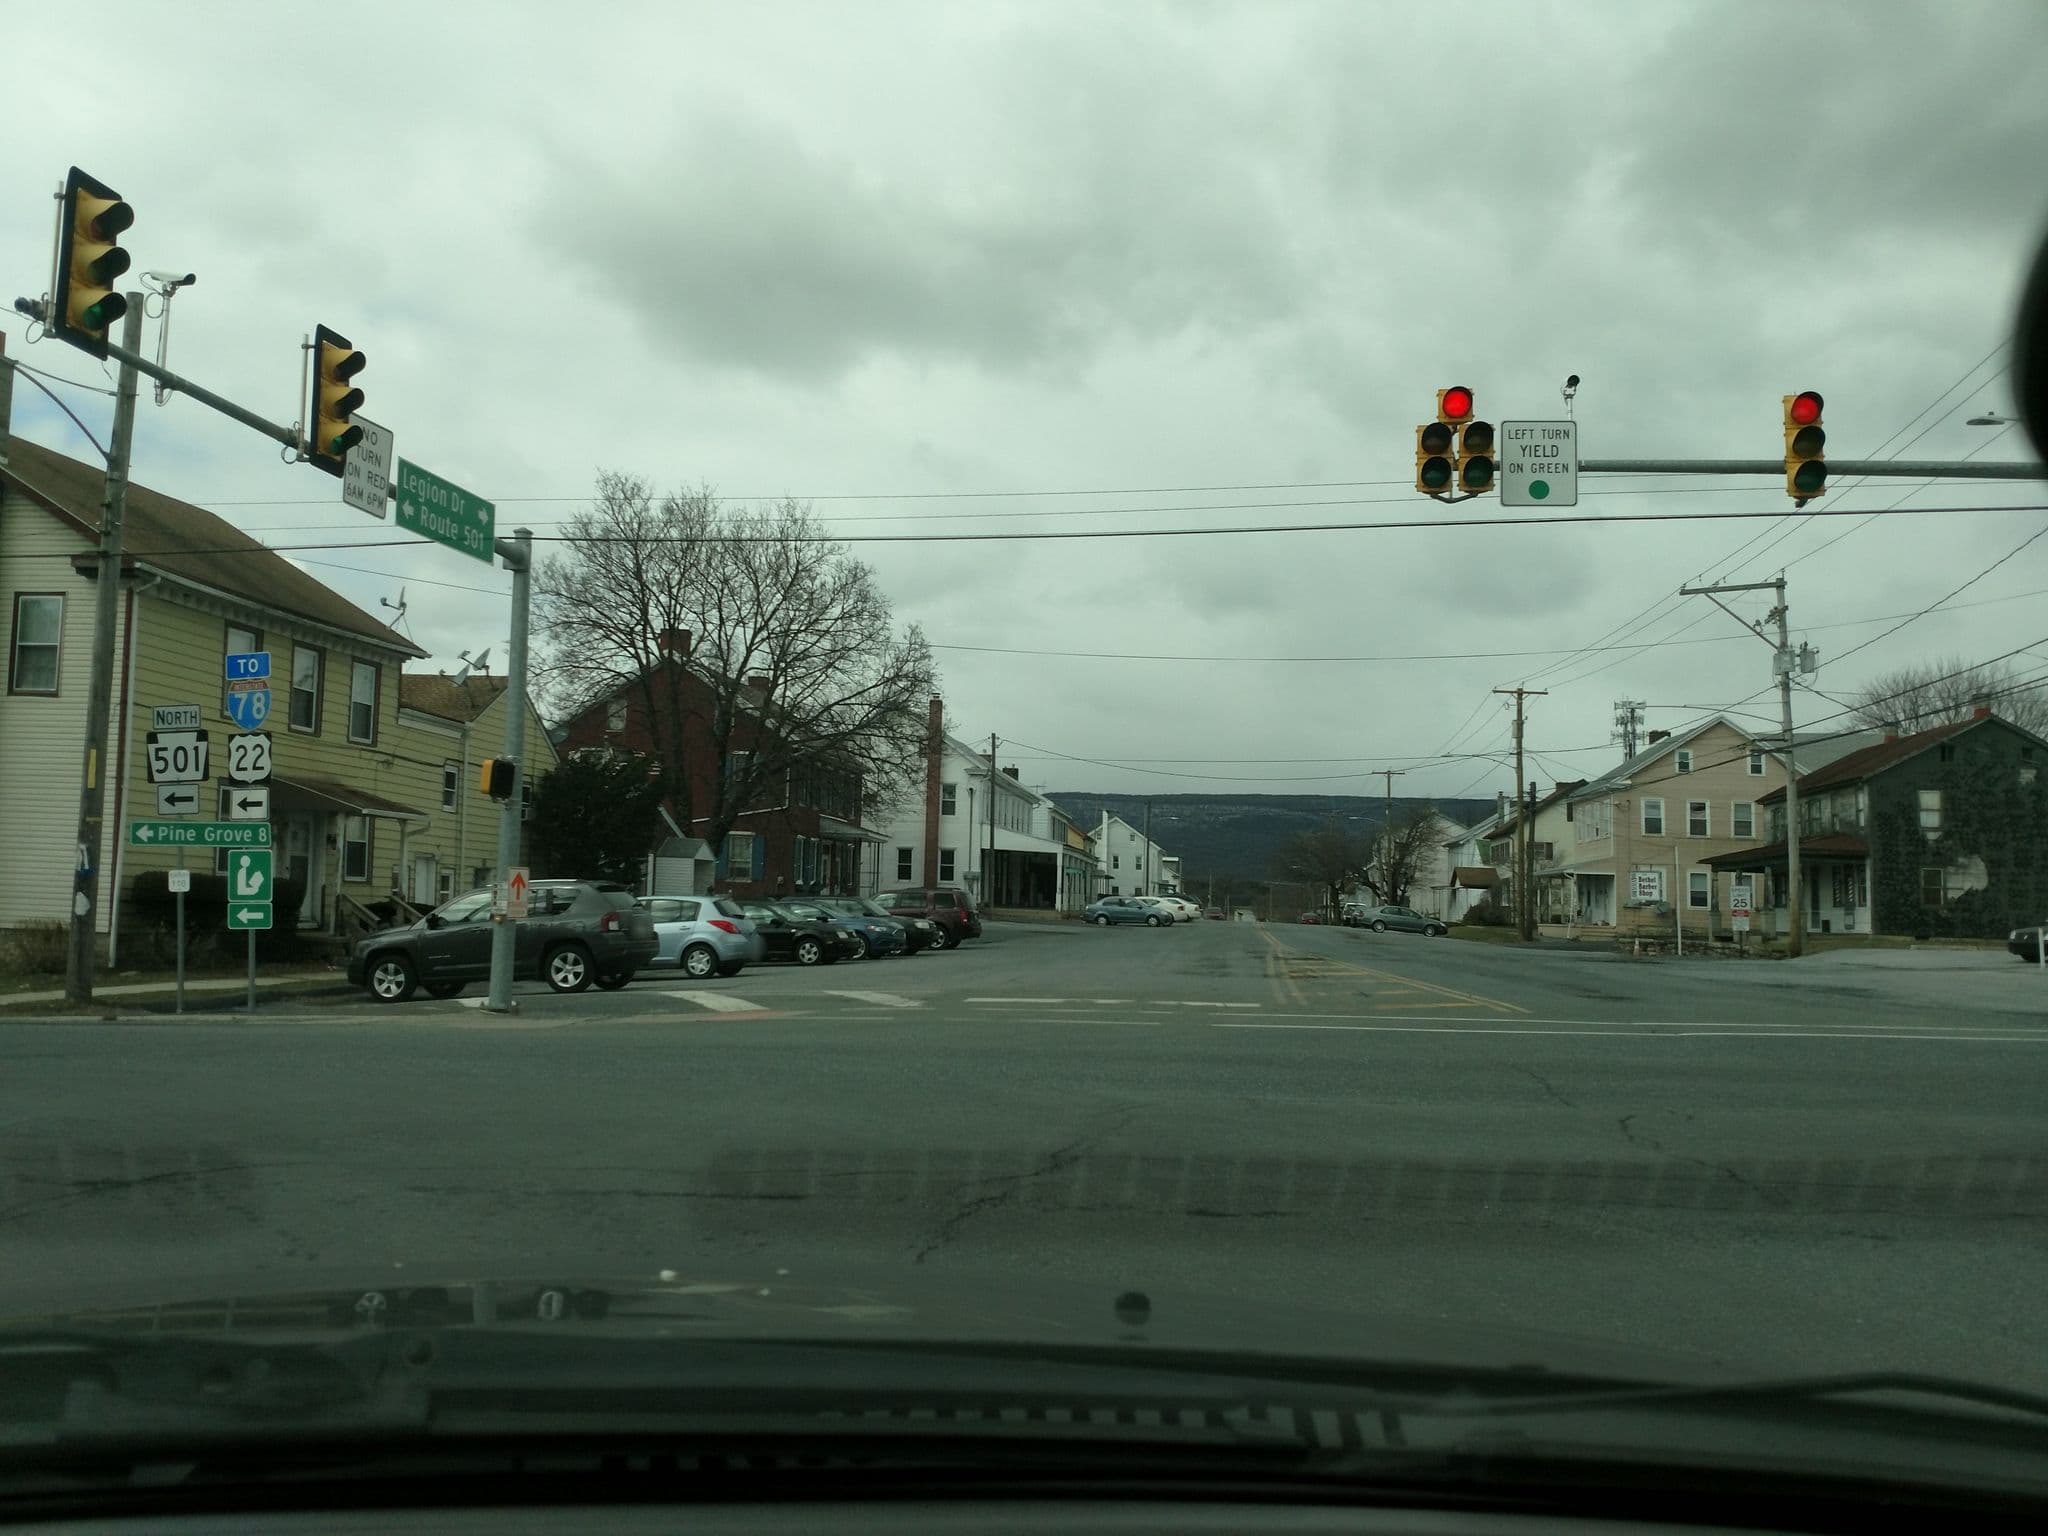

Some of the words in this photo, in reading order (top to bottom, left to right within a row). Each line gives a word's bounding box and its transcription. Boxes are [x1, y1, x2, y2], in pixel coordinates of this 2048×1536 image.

[361, 427, 378, 446] NO
[1508, 428, 1535, 440] LEFT
[1541, 429, 1570, 440] TURN
[356, 445, 381, 468] TURN
[1519, 445, 1559, 458] YIELD
[347, 462, 361, 480] ON
[367, 471, 386, 491] RED
[1508, 463, 1524, 474] ON
[1531, 462, 1569, 473] GREEN
[346, 483, 364, 500] 6AM
[367, 494, 384, 511] 6PM
[403, 467, 447, 507] Legion
[451, 492, 465, 515] Dr
[421, 506, 458, 539] Route
[464, 526, 484, 551] 501
[237, 658, 259, 673] TO
[234, 693, 266, 720] 78
[156, 710, 198, 726] NORTH
[154, 746, 200, 774] 501
[235, 744, 265, 772] 22
[158, 827, 195, 841] Pine
[204, 827, 253, 842] Grove
[258, 827, 267, 842] 8
[1638, 889, 1653, 897] Shop
[1732, 898, 1748, 908] 25
